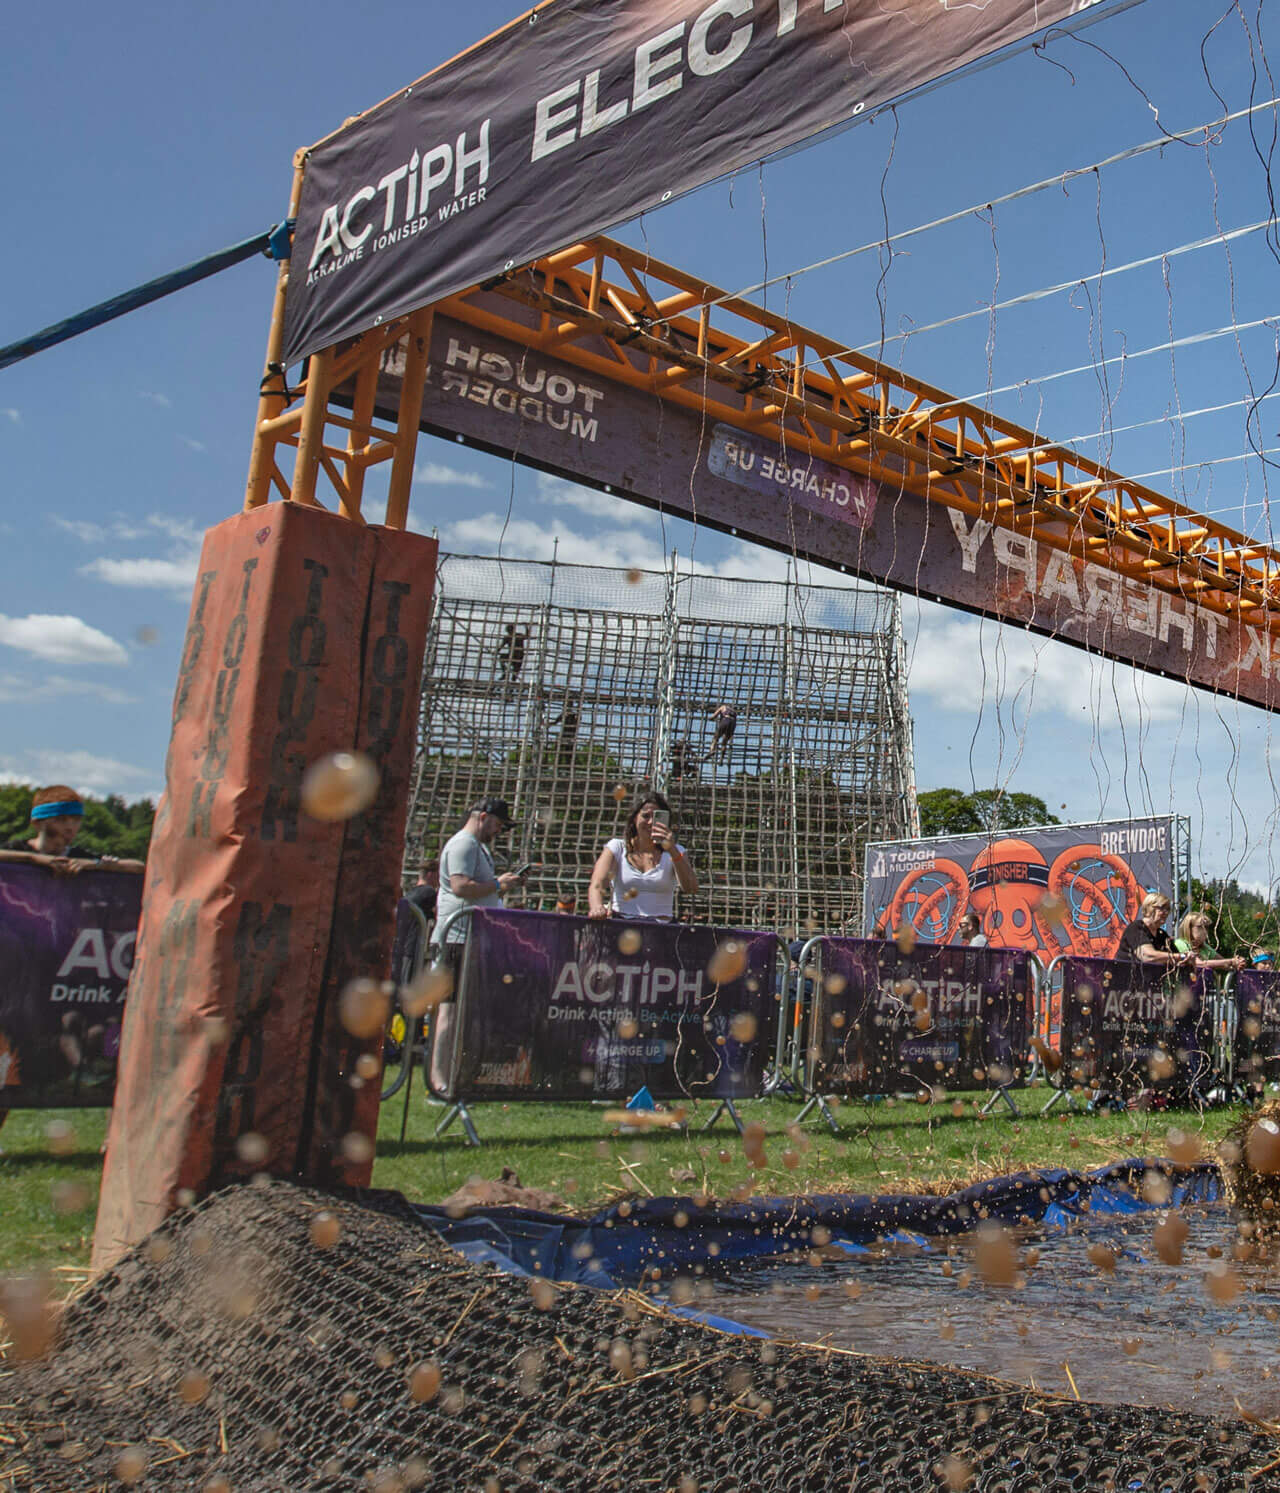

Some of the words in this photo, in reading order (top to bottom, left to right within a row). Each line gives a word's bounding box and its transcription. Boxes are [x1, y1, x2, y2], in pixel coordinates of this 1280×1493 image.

[531, 0, 845, 163] ELEC
[372, 217, 428, 252] IONISED
[438, 187, 487, 220] WATER
[1101, 827, 1166, 855] BREWDOG
[889, 851, 935, 861] TOUGH
[889, 860, 936, 873] MUDDER
[986, 863, 1028, 883] FINISHER
[50, 983, 110, 1003] Drink
[548, 1005, 585, 1021] Drink
[640, 1008, 658, 1023] Be
[645, 1046, 661, 1058] UP
